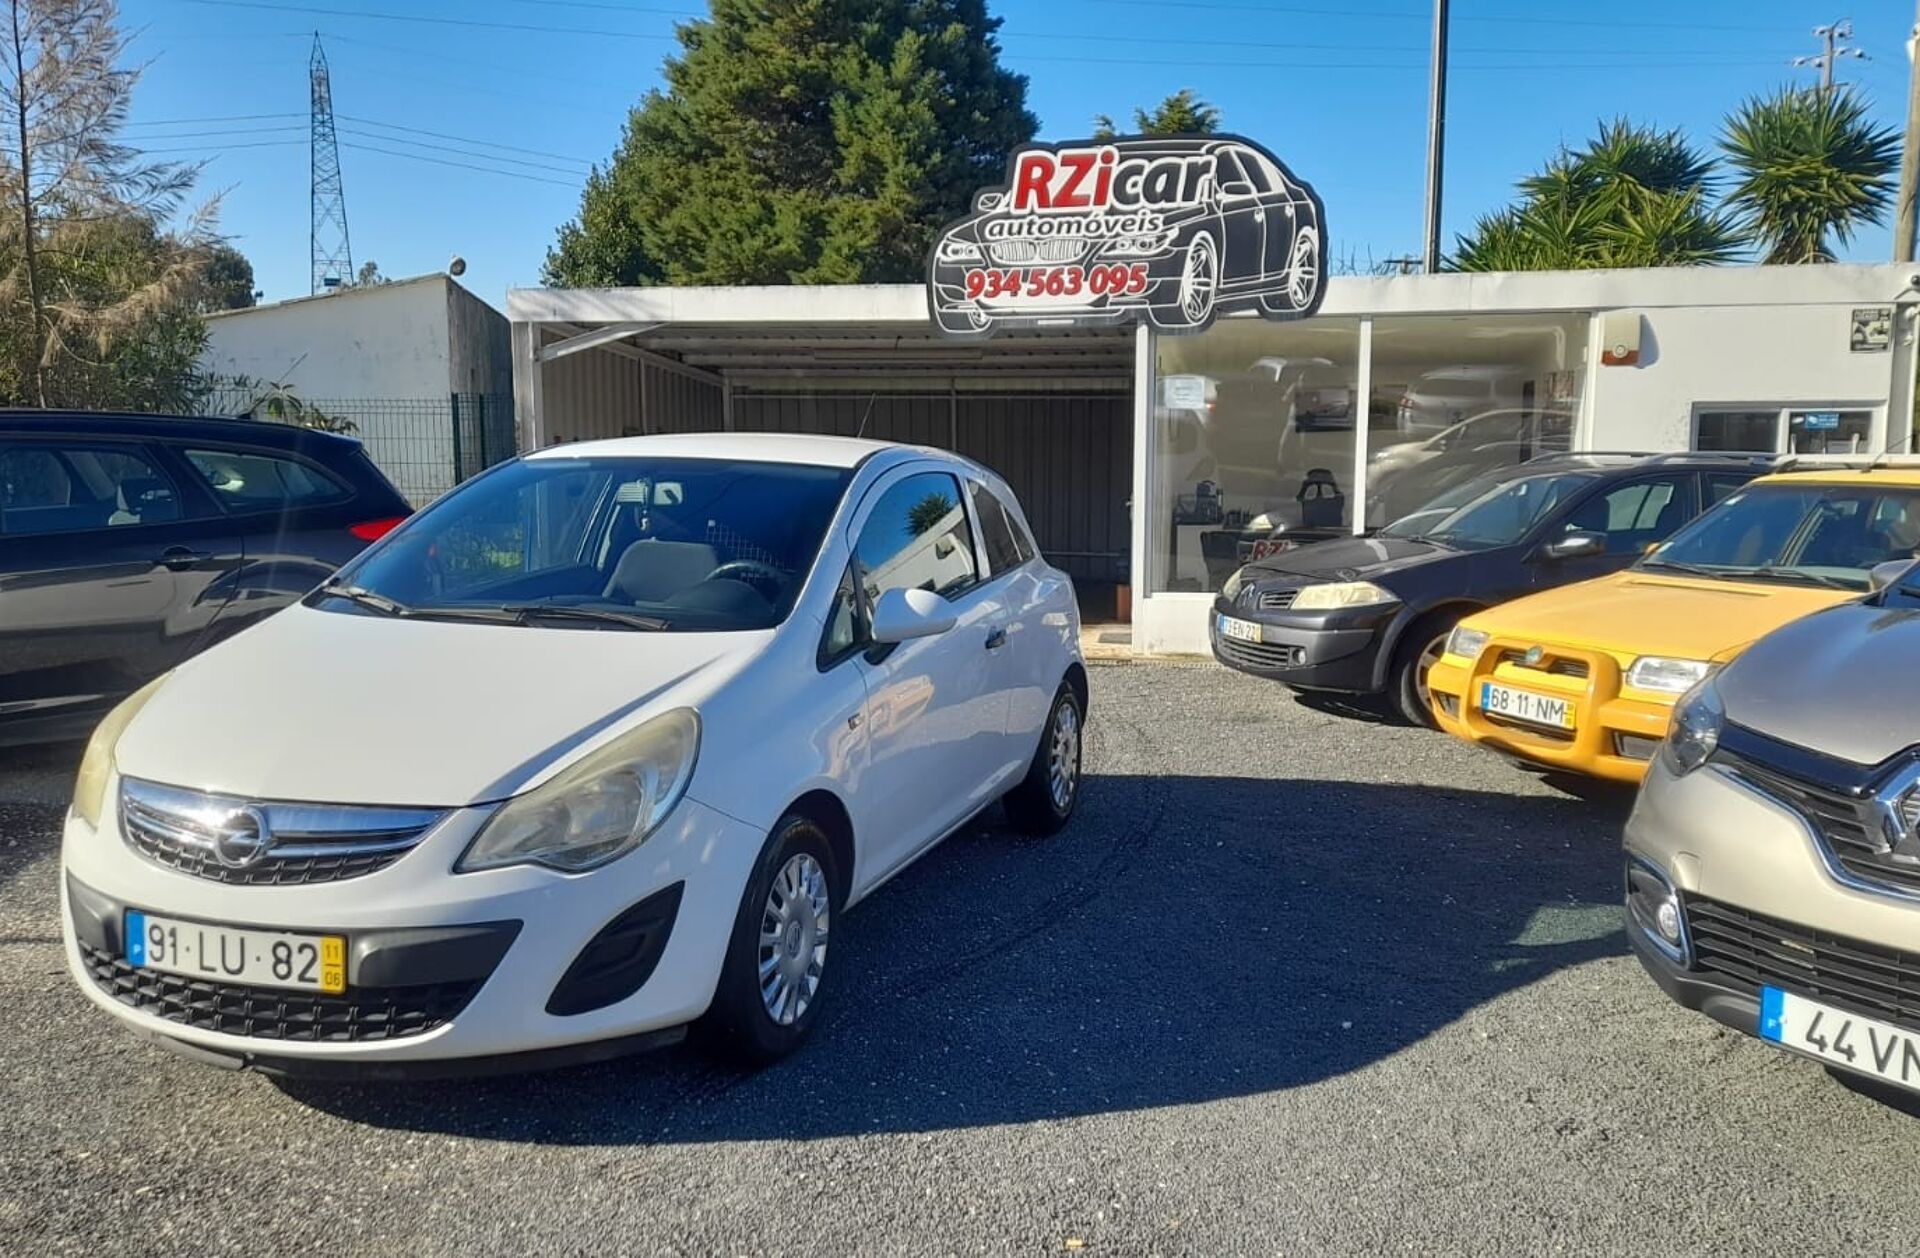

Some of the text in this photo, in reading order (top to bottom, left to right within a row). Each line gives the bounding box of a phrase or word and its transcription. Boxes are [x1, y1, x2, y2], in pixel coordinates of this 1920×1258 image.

[987, 213, 1161, 238] automóveis
[966, 264, 1148, 299] 934 563 095
